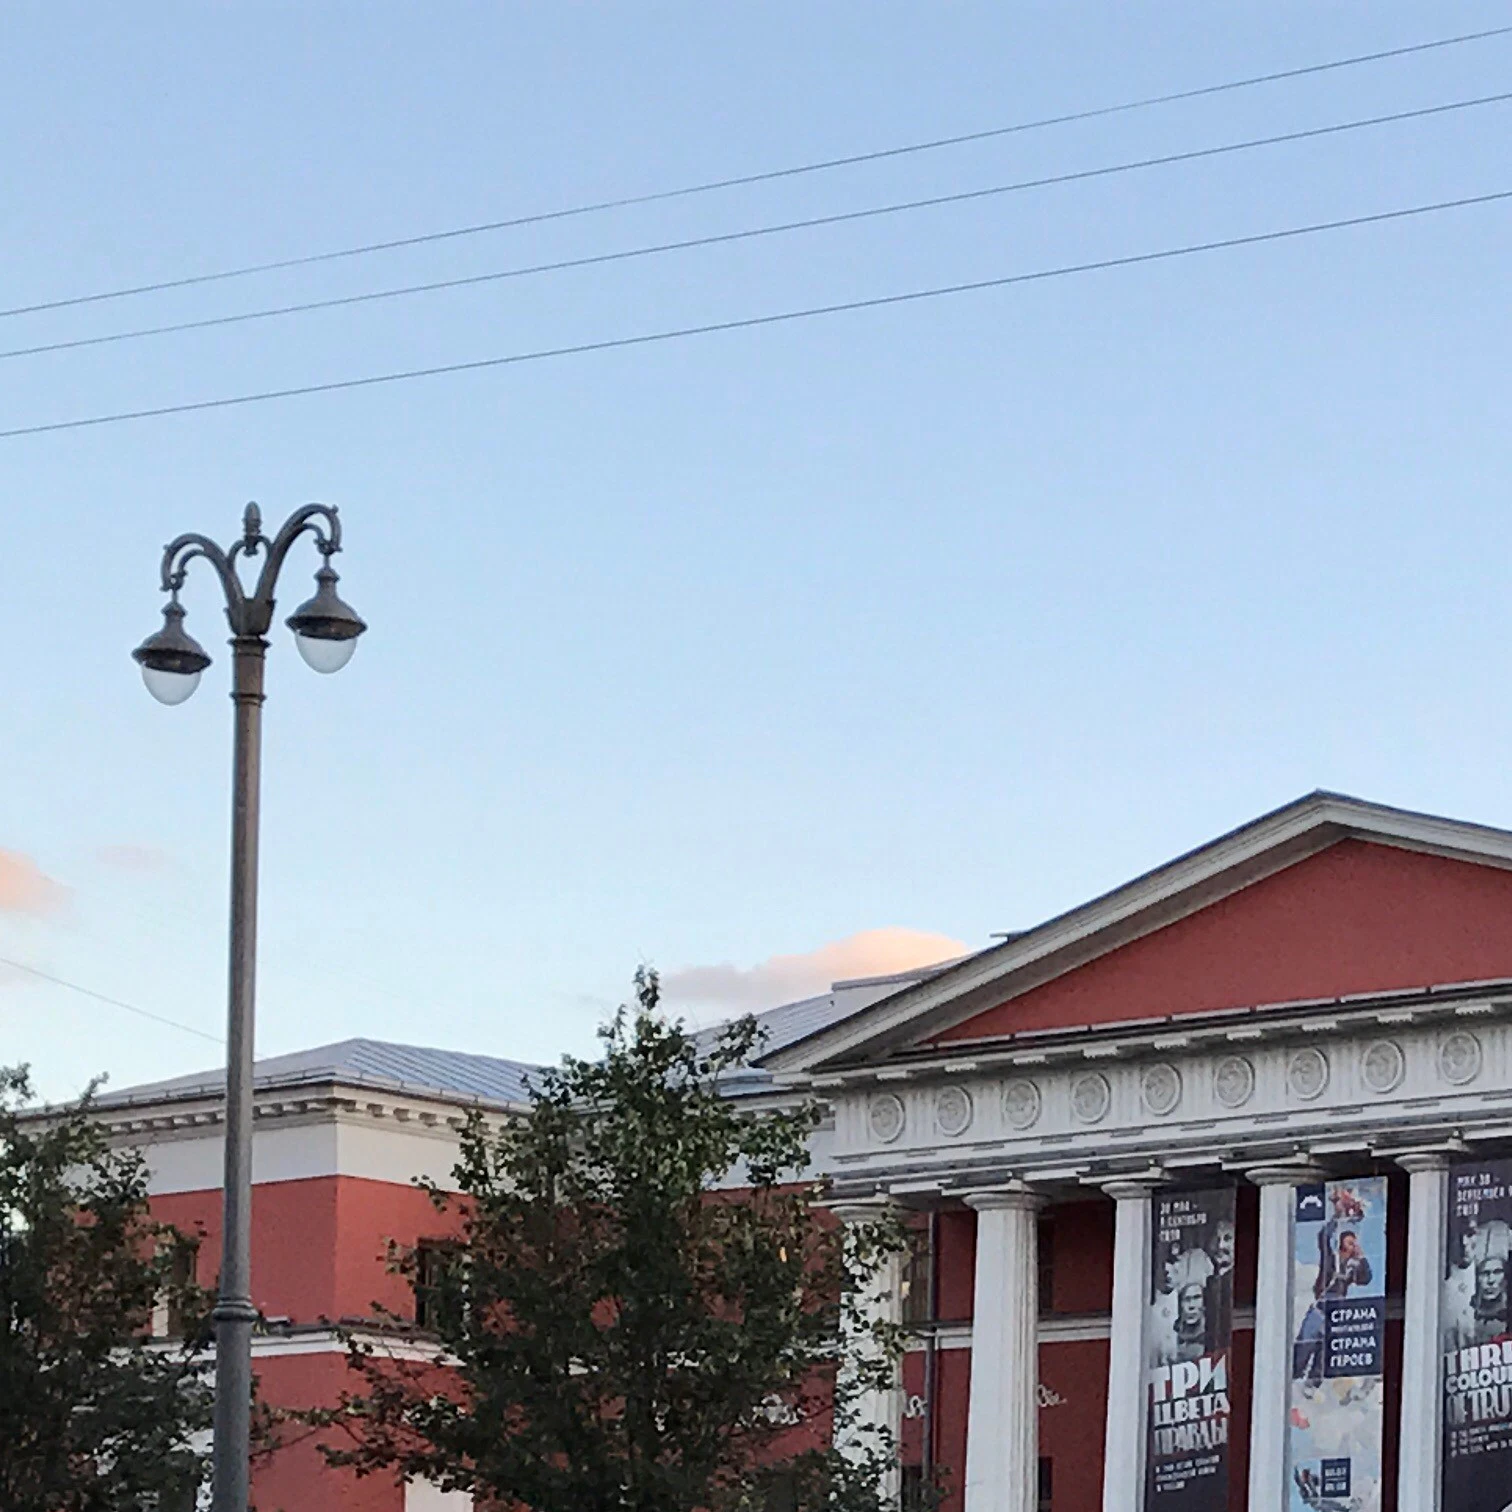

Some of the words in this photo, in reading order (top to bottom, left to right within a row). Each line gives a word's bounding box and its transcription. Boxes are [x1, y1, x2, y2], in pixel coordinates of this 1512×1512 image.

[1457, 1186, 1505, 1202] SEPTEMBER
[1331, 1307, 1377, 1323] СТРАНА
[1331, 1335, 1376, 1351] СТРАНА
[1330, 1353, 1373, 1367] ГЕРОЕВ
[1147, 1355, 1227, 1402] ТРИ
[1153, 1392, 1230, 1427] ЦВЕТА
[1446, 1392, 1467, 1424] OF
[1154, 1417, 1228, 1455] ПРАВДЫ
